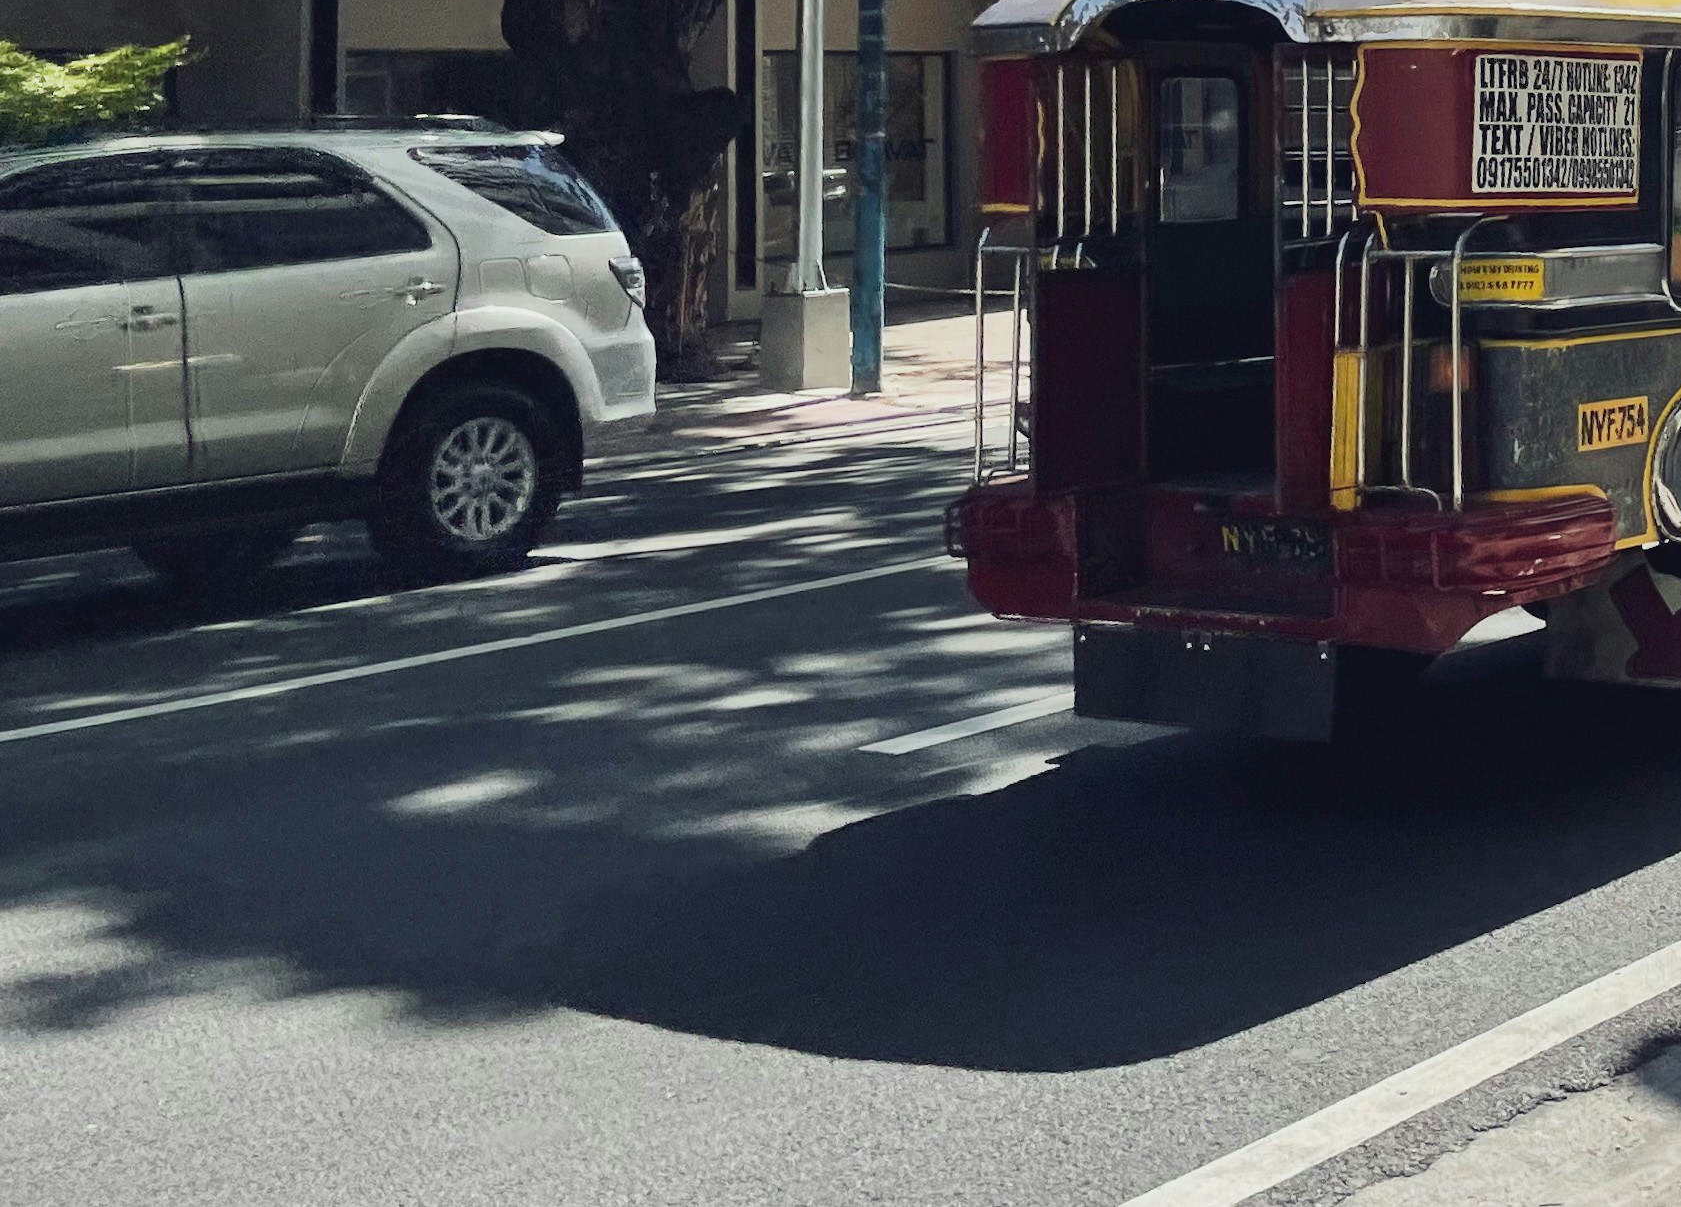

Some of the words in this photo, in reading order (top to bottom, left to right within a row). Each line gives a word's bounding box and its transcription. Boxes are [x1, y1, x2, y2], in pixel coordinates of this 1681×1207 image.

[1480, 57, 1528, 90] LTFRB
[1533, 59, 1564, 92] 24/7
[1614, 64, 1638, 95] 1342
[1479, 91, 1522, 122] MAX.
[1527, 93, 1565, 124] PASS.
[1568, 94, 1618, 125] CAPACITY
[1623, 96, 1636, 126] 21
[1479, 124, 1523, 155] TEXT
[1527, 124, 1536, 156] /
[1539, 125, 1579, 157] VIBER
